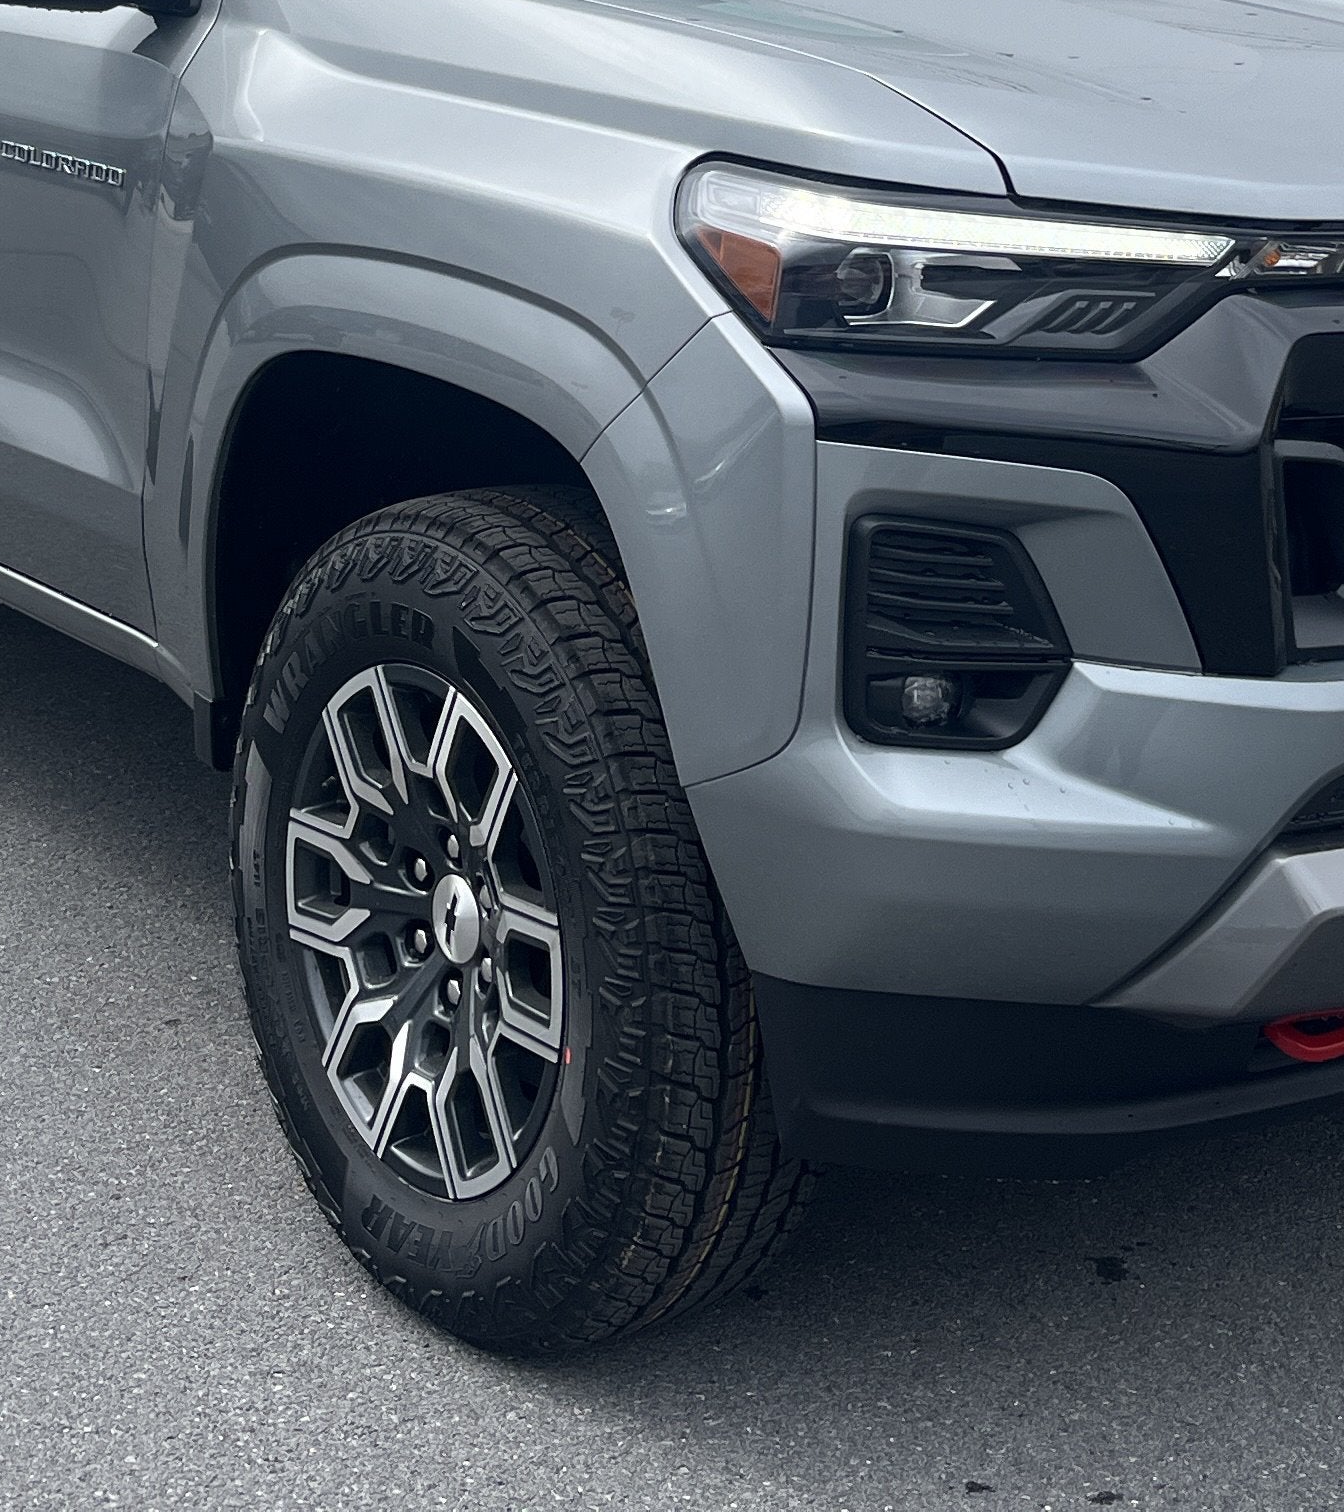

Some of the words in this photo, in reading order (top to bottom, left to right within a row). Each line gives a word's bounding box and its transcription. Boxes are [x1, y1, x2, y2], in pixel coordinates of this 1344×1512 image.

[0, 139, 127, 187] COLORADO
[262, 600, 435, 735] WRANGLER
[361, 1145, 559, 1272] GOODYEAR
